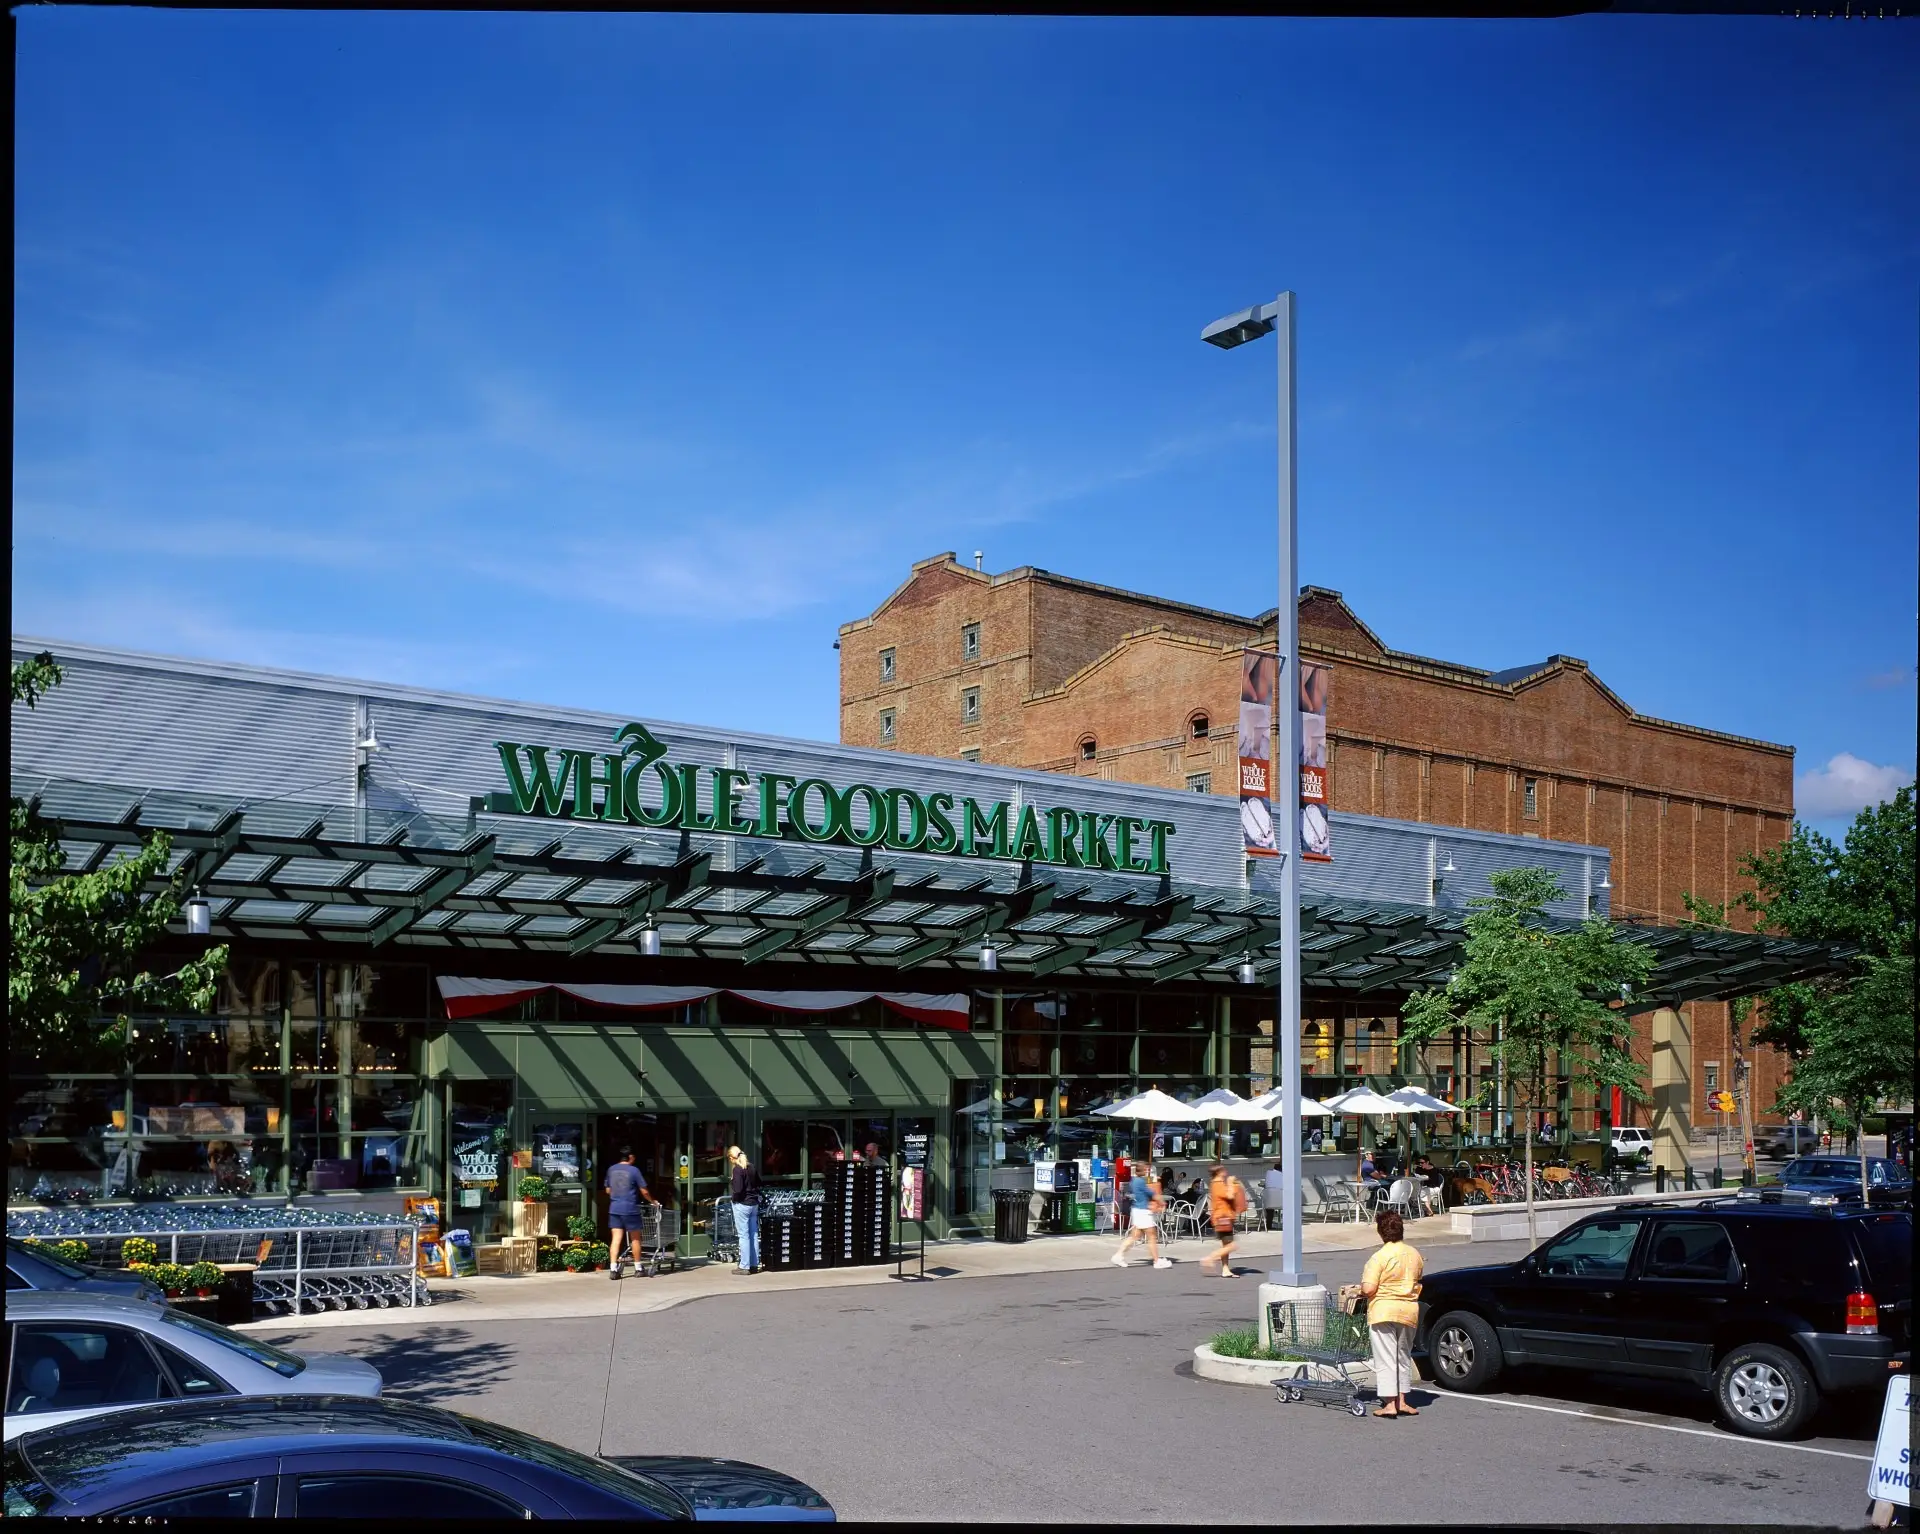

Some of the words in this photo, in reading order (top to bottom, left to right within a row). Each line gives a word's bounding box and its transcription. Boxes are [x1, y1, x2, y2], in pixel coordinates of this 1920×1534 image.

[1242, 764, 1266, 778] WHOLE
[1243, 776, 1265, 787] FOODS
[1301, 772, 1323, 785] WHOLE
[1301, 783, 1322, 794] FOODS
[493, 724, 754, 836] WHOLE
[756, 773, 957, 852] FOODS
[961, 796, 1176, 875] MARKET
[453, 1138, 482, 1156] Welcome
[458, 1153, 499, 1165] WHOLE
[461, 1164, 497, 1175] FOODS
